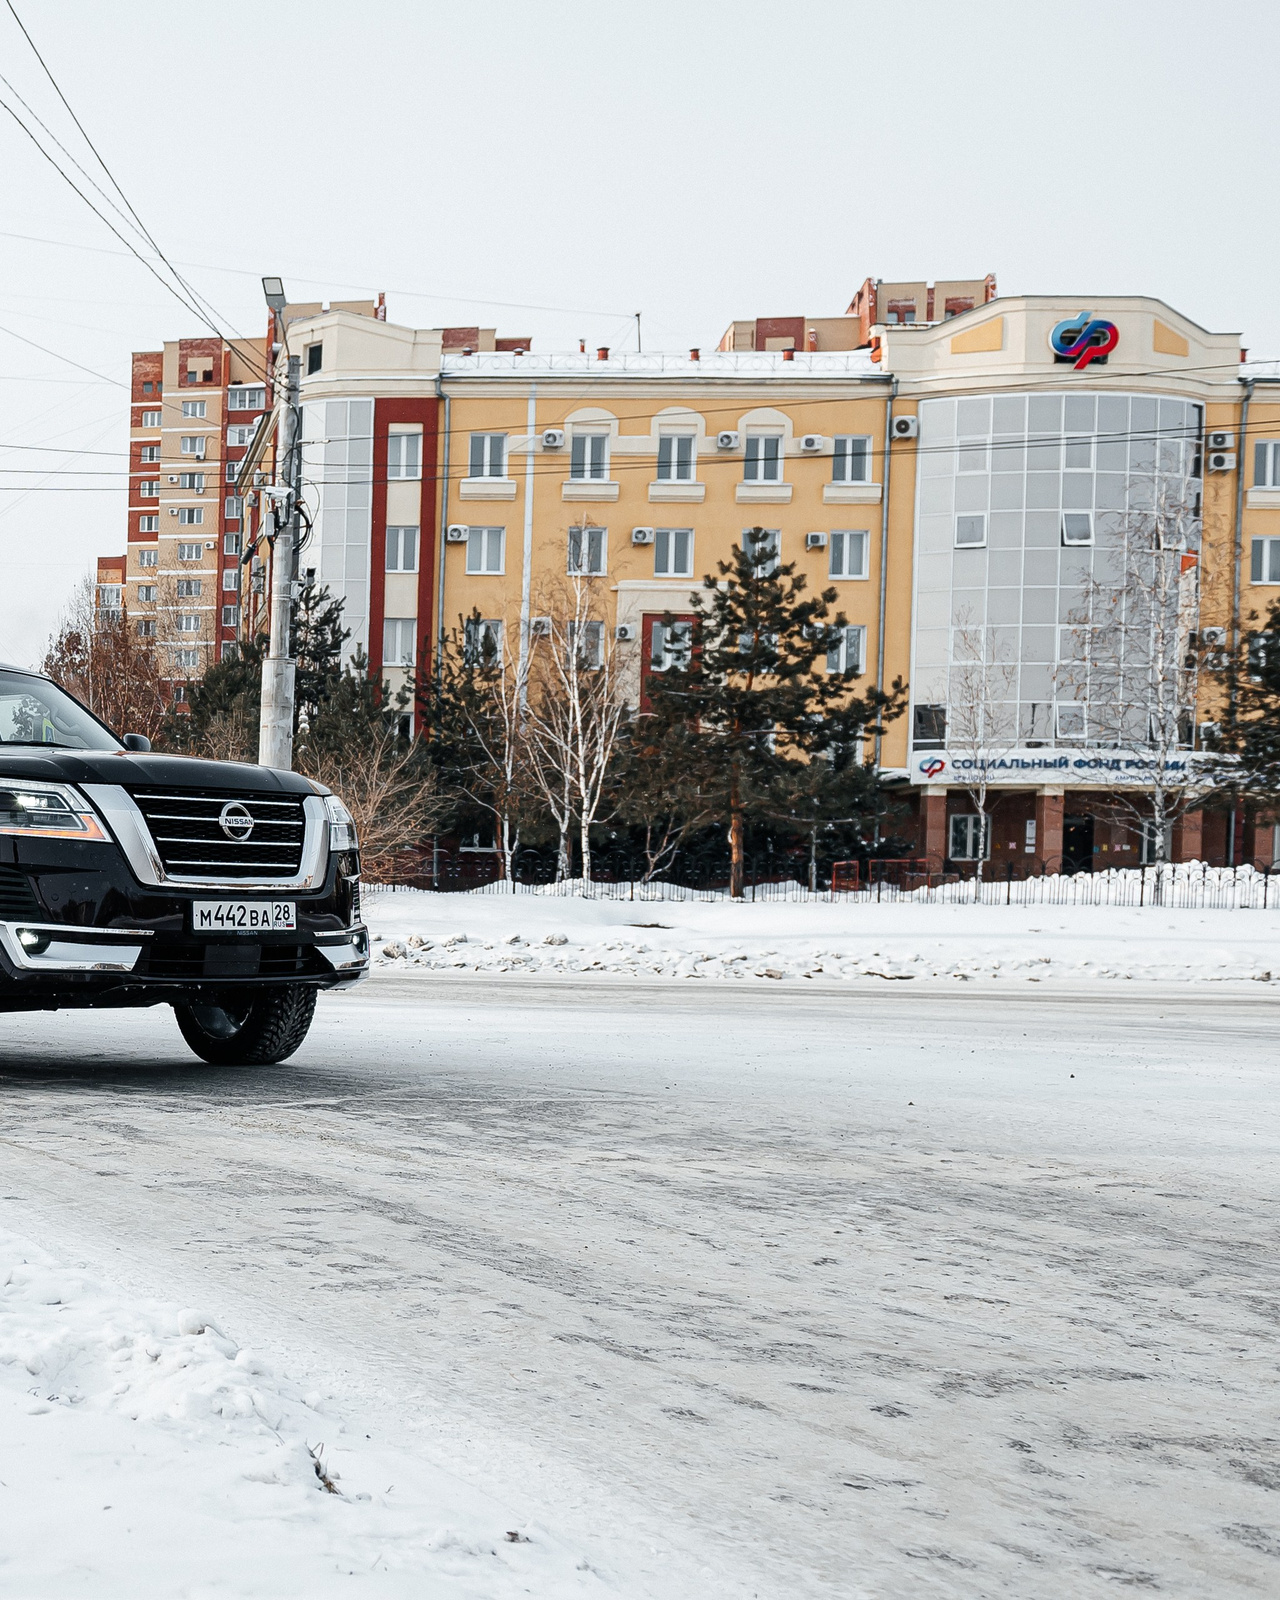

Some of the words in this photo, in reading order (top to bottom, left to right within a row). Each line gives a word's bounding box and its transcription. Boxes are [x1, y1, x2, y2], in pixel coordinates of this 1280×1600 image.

[951, 756, 1069, 771] СОЦИАЛЬНЫЙ
[1073, 758, 1121, 771] ФОНД
[1125, 759, 1186, 771] РОСИИ
[224, 818, 253, 826] NISSAN
[274, 904, 291, 921] 28
[273, 920, 286, 928] RUS
